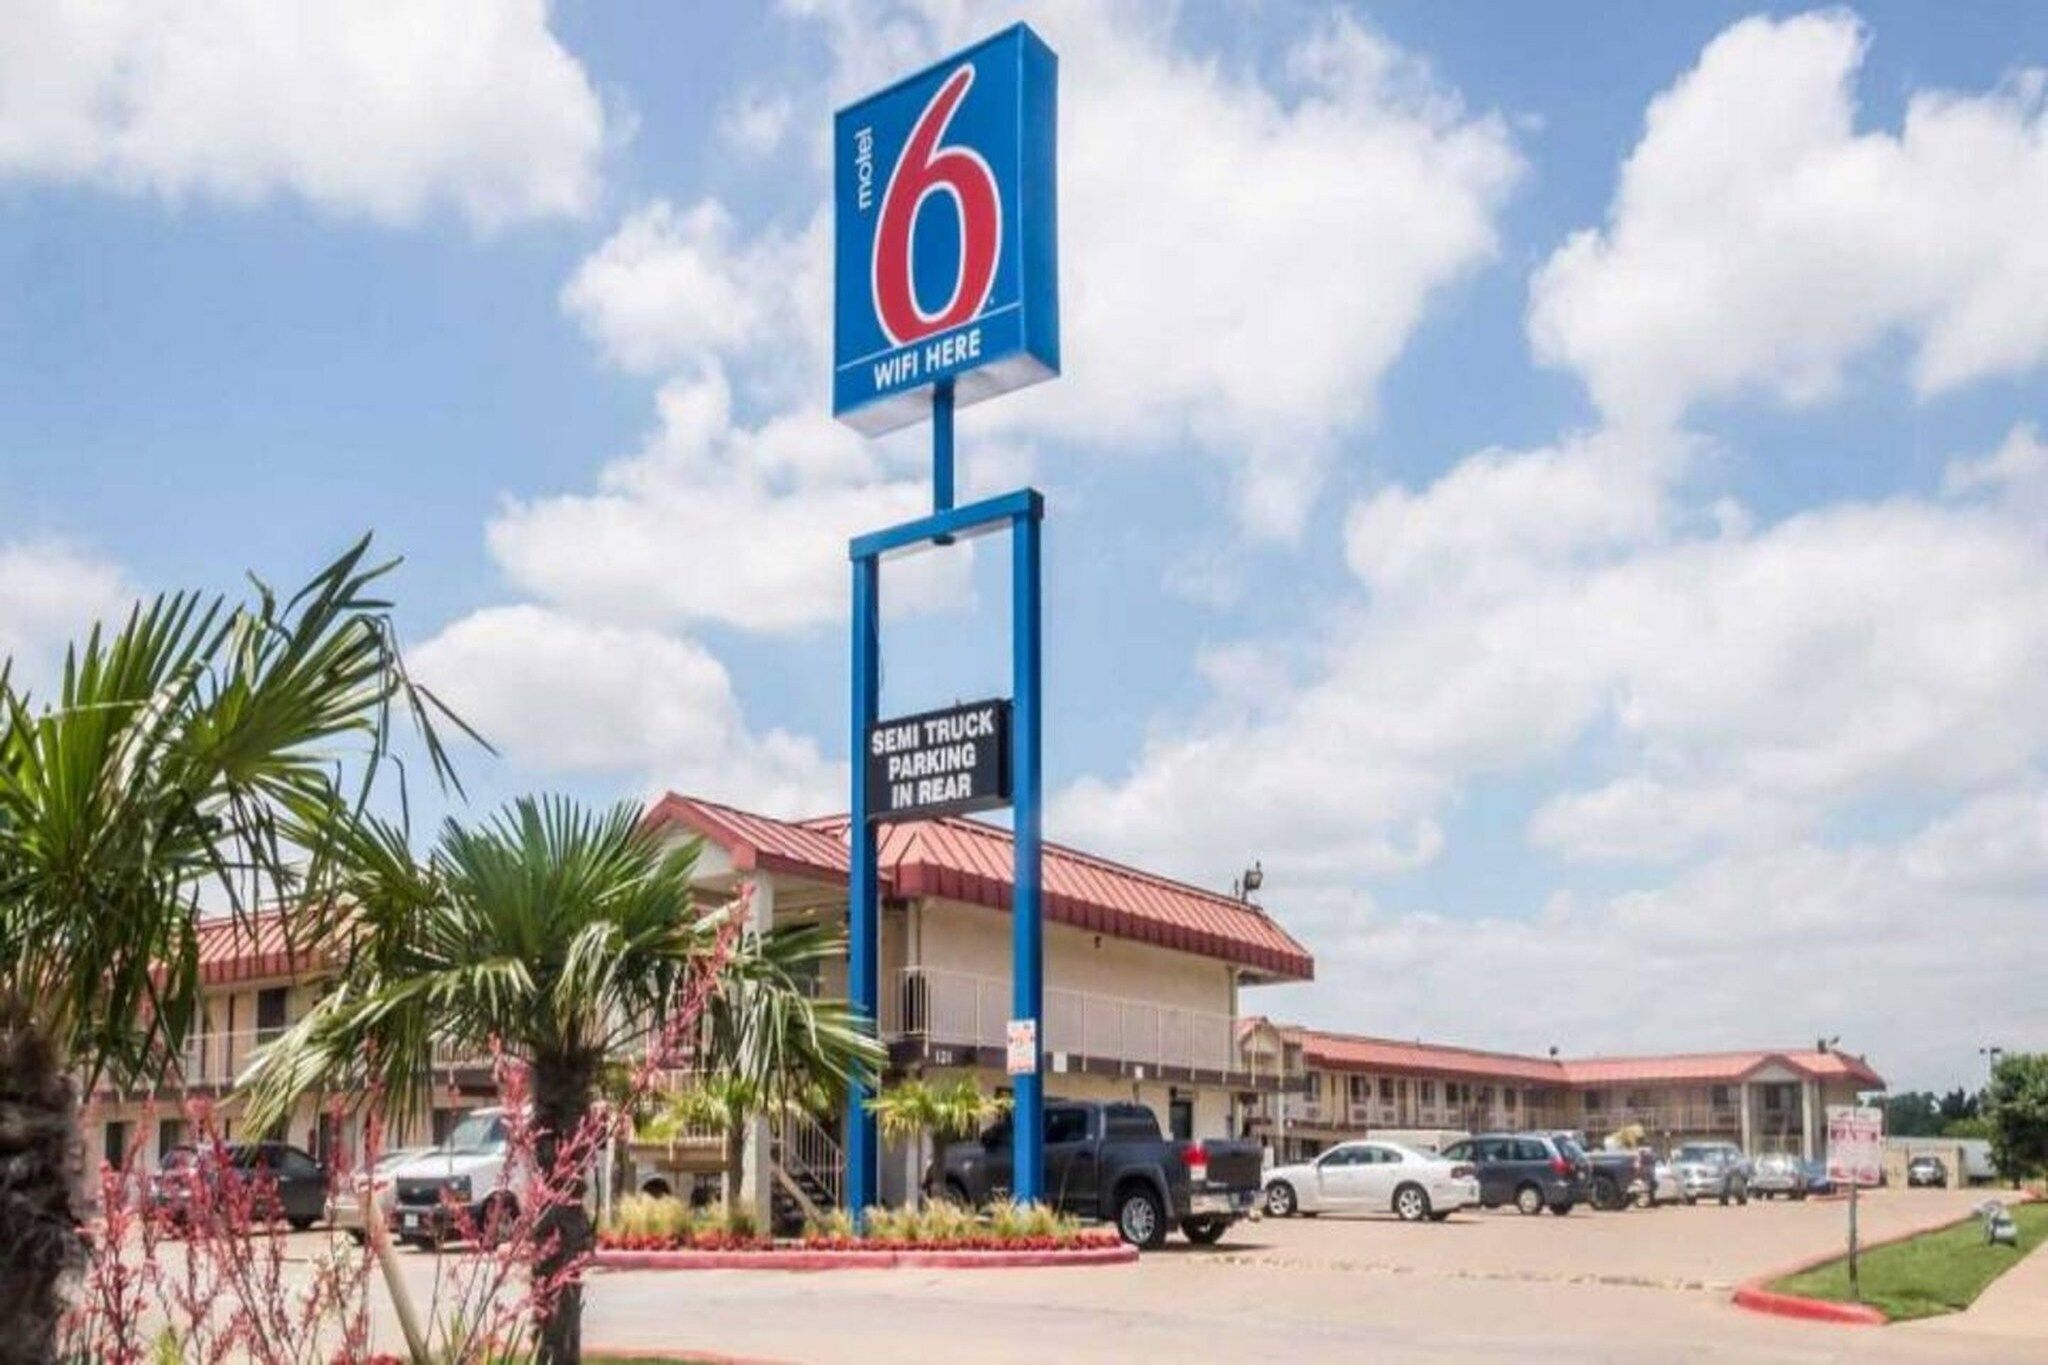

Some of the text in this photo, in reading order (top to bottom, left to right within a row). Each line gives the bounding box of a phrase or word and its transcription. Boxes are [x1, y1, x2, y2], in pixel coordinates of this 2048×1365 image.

[854, 126, 873, 210] motel
[871, 63, 1003, 348] 6
[874, 327, 981, 391] WIFI HERE
[872, 708, 993, 755] SEMI TRUCK
[889, 742, 976, 780] PARKING
[892, 773, 971, 809] IN REAR
